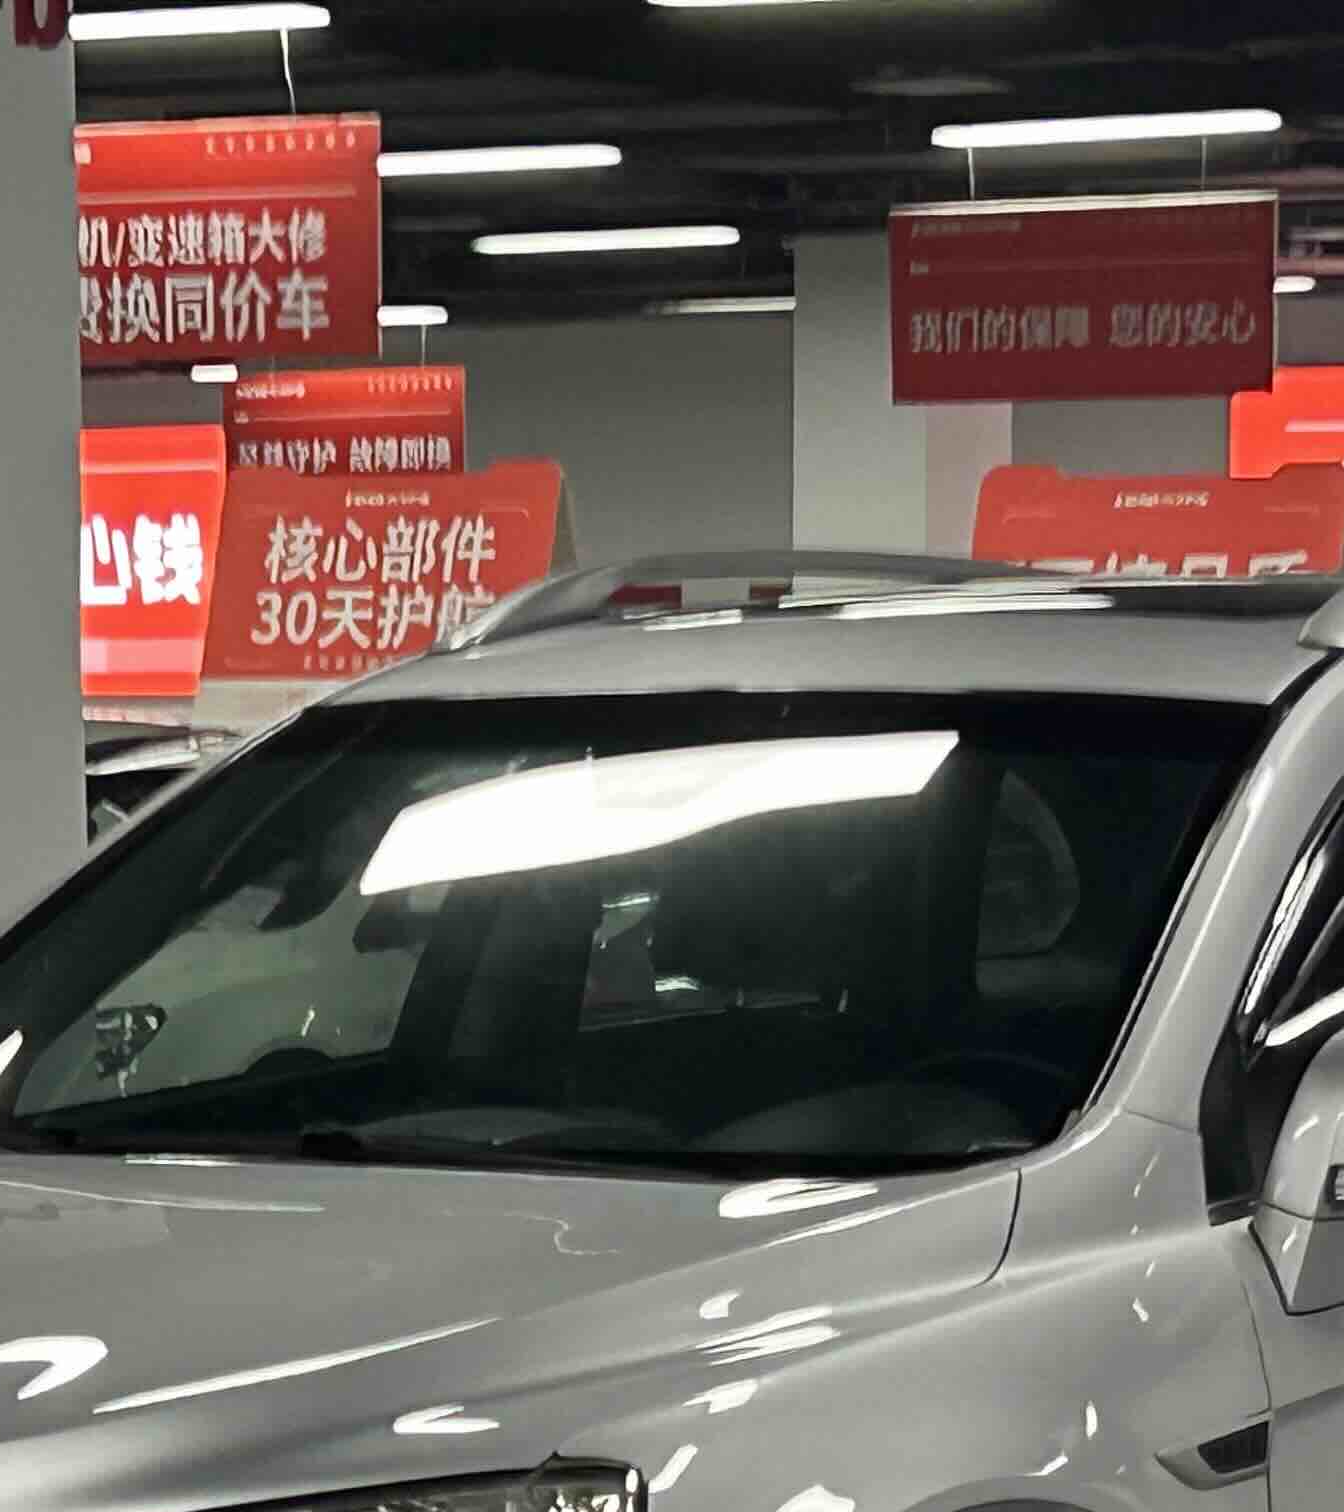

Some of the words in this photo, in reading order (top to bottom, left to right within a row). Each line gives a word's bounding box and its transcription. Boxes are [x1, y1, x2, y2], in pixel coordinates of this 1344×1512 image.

[1109, 300, 1256, 347] 您的安心
[264, 514, 496, 584] 核心部件
